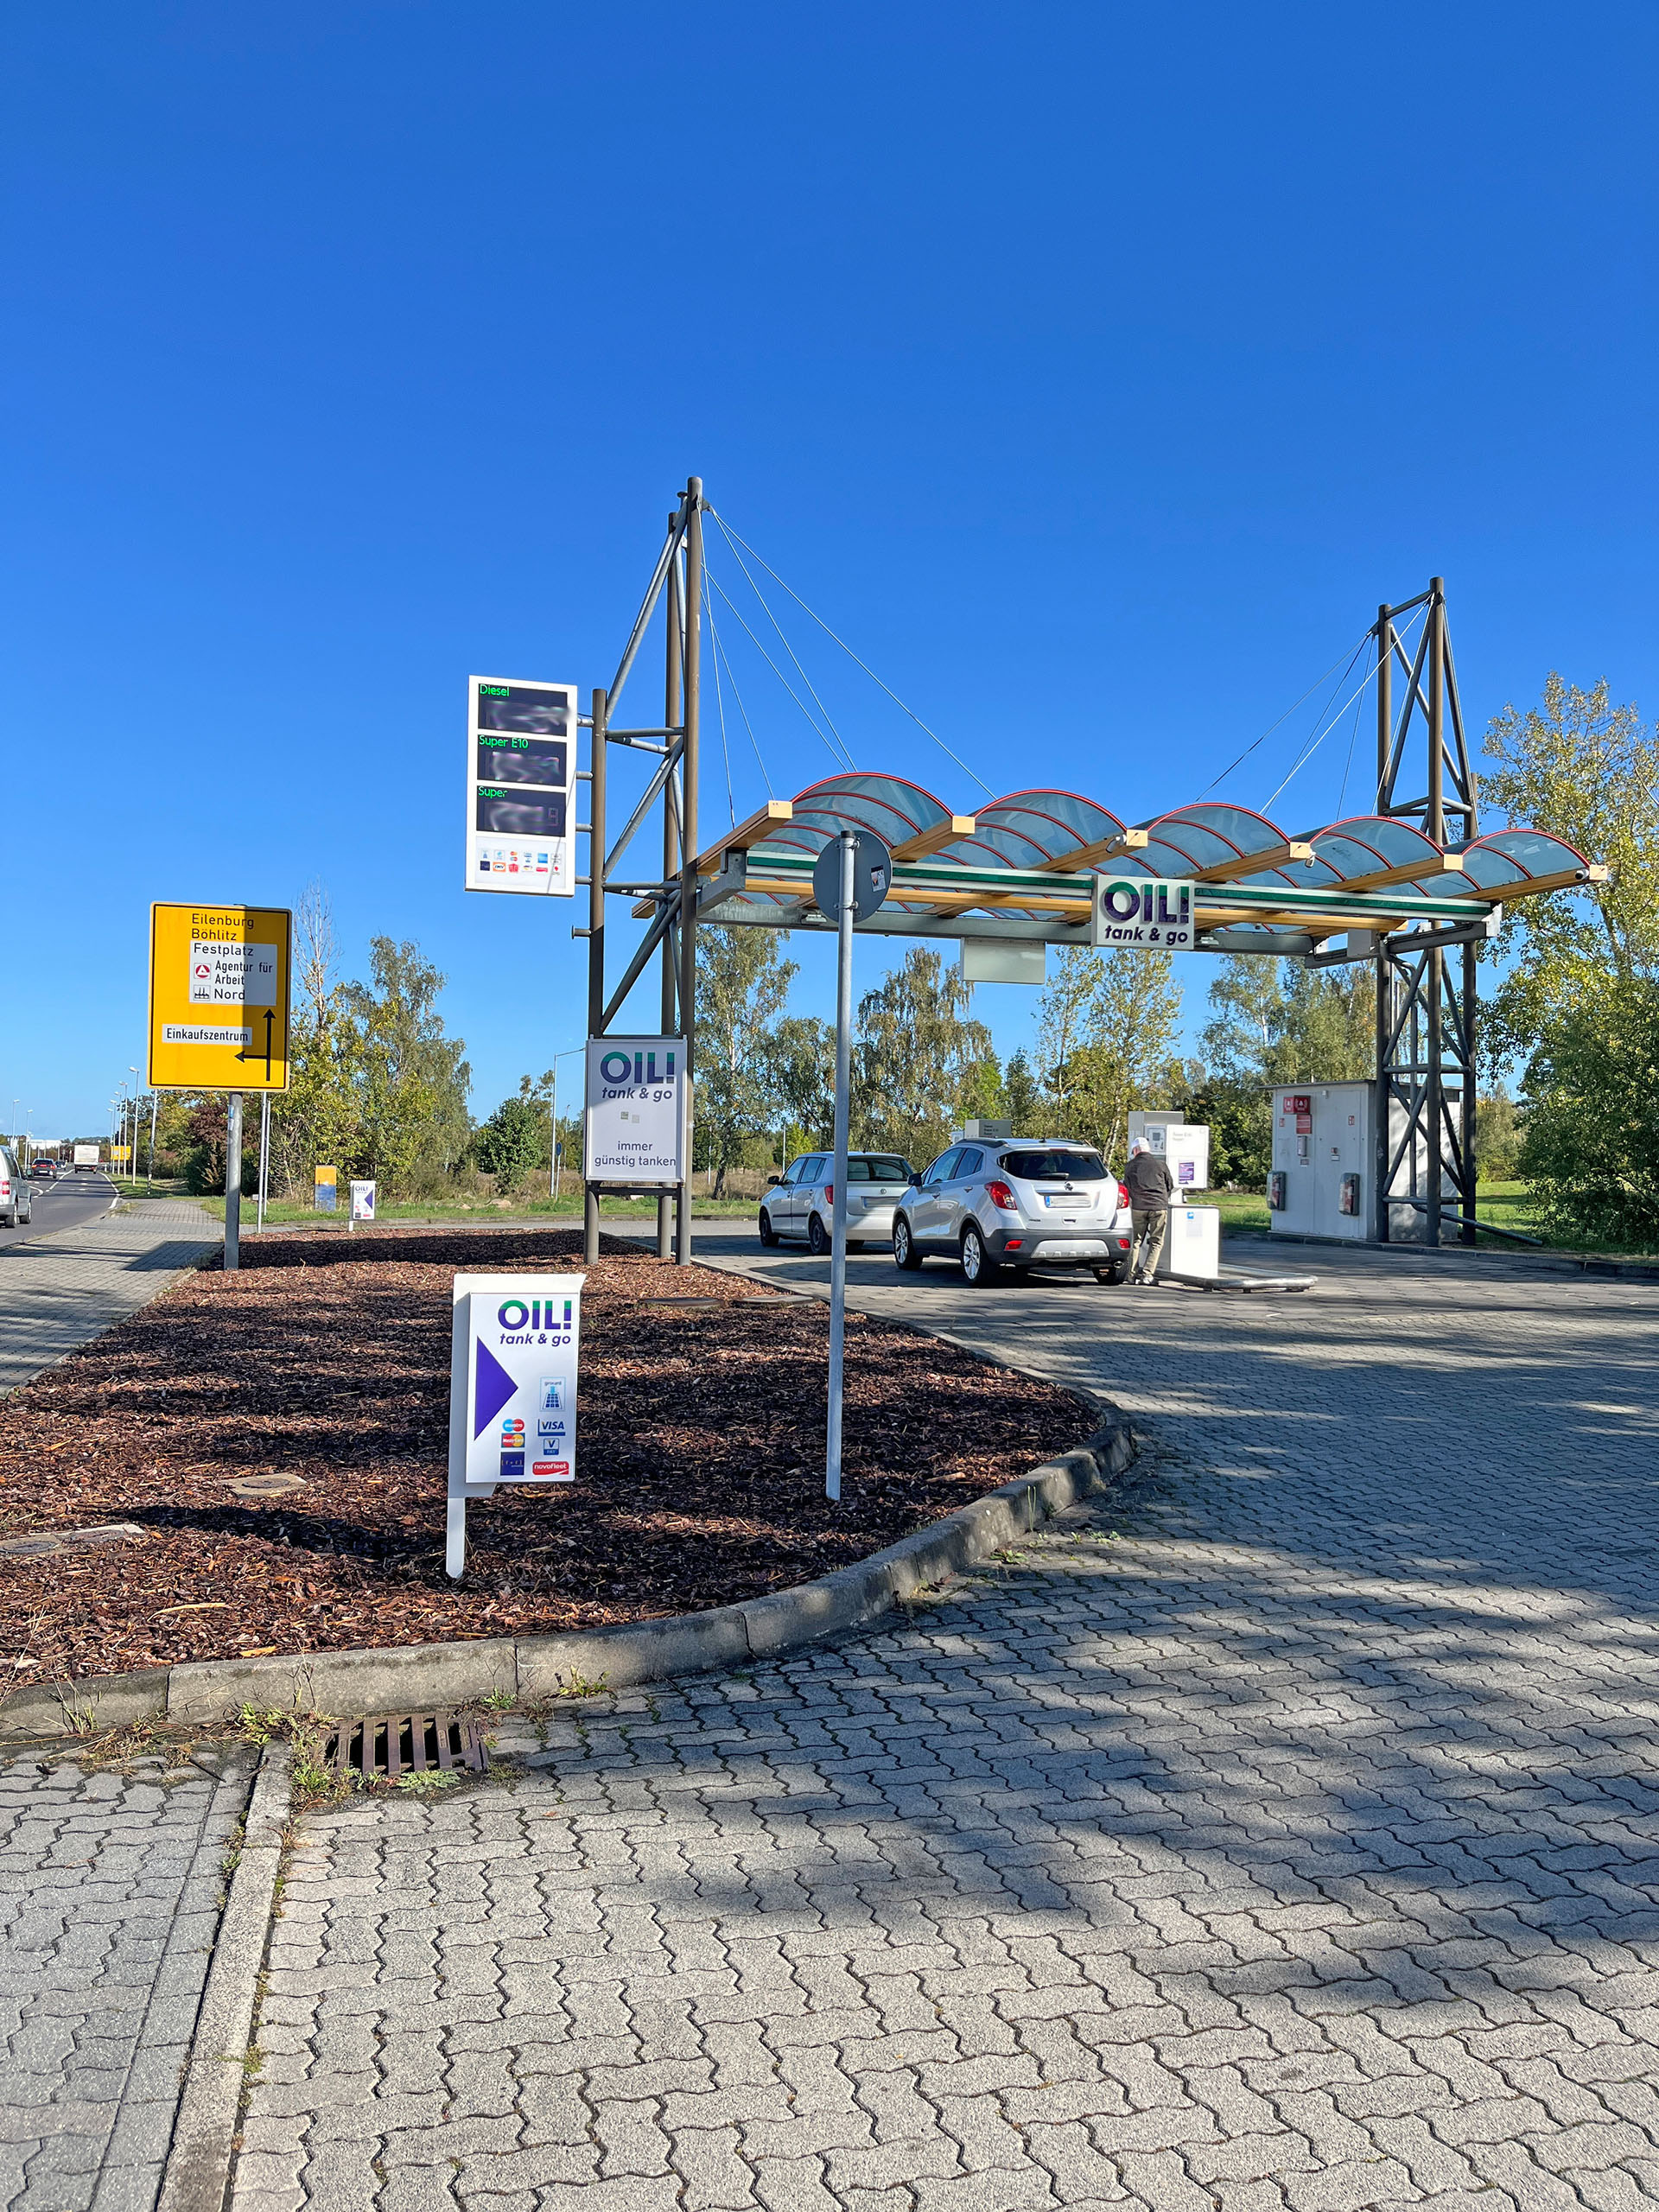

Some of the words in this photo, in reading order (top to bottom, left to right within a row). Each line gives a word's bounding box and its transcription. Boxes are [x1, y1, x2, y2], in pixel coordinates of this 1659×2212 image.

[480, 683, 510, 697] Diesel
[479, 734, 509, 748] Super
[512, 737, 529, 749] E10
[478, 785, 508, 798] Super
[1102, 880, 1190, 924] OIL!
[192, 913, 254, 929] Eilenburg
[191, 928, 237, 941] Böhlitz
[1104, 925, 1145, 941] tank
[1148, 927, 1160, 941] &
[1166, 931, 1188, 946] go
[194, 943, 254, 957] Festplatz
[215, 960, 253, 973] Agentur
[258, 962, 273, 974] für
[215, 974, 245, 985] Arbeit
[214, 988, 245, 1001] Nord
[167, 1027, 249, 1042] Einkaufszentrum
[600, 1051, 676, 1084] OIL!
[601, 1086, 636, 1099] tank
[639, 1087, 649, 1099] &
[653, 1089, 673, 1103] go
[617, 1140, 653, 1151] immer
[594, 1154, 636, 1168] günstig
[639, 1156, 677, 1167] tanken
[497, 1300, 572, 1331] OIL!
[499, 1333, 534, 1345] tank
[537, 1333, 549, 1345] &
[551, 1335, 571, 1347] go
[541, 1421, 565, 1431] VISA
[547, 1440, 556, 1448] V
